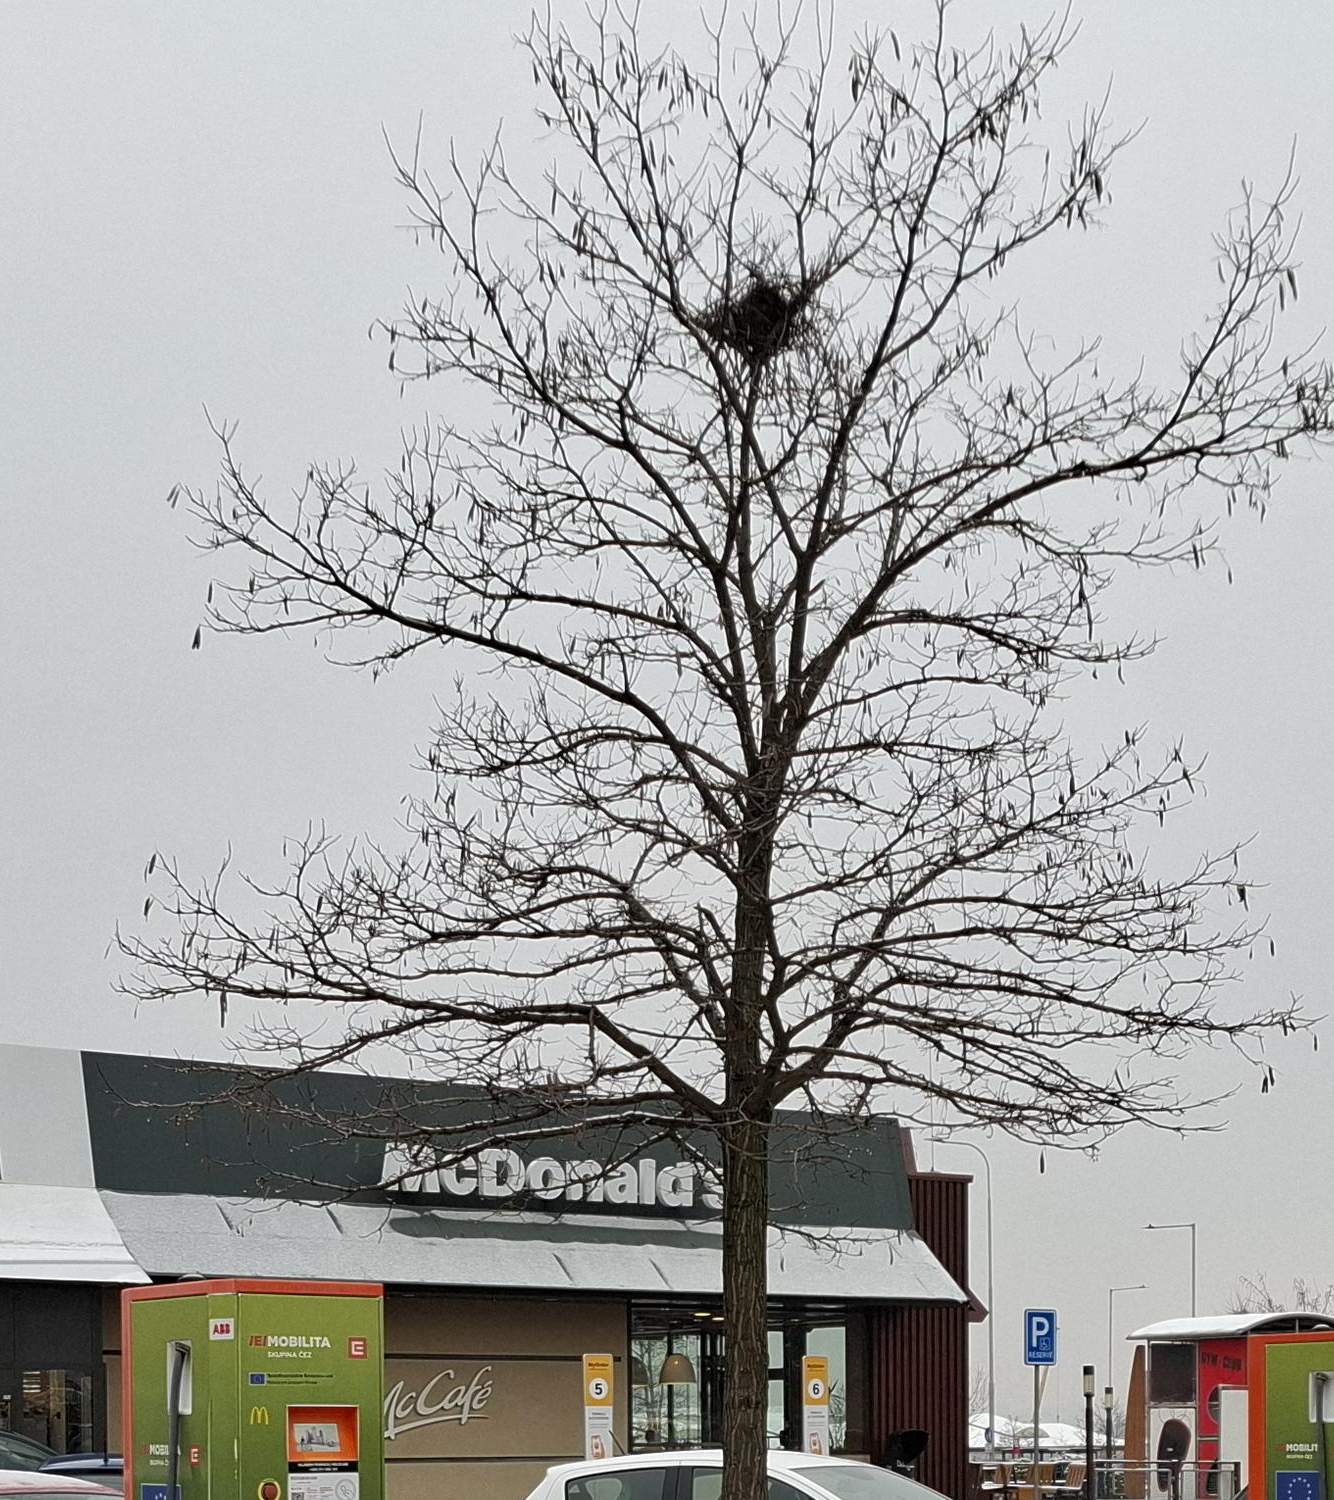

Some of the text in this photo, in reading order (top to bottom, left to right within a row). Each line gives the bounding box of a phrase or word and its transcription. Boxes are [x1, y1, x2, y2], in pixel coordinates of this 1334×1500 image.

[212, 1323, 231, 1335] ABB
[1032, 1316, 1050, 1348] P
[594, 1383, 604, 1396] 5
[812, 1383, 821, 1396] 6
